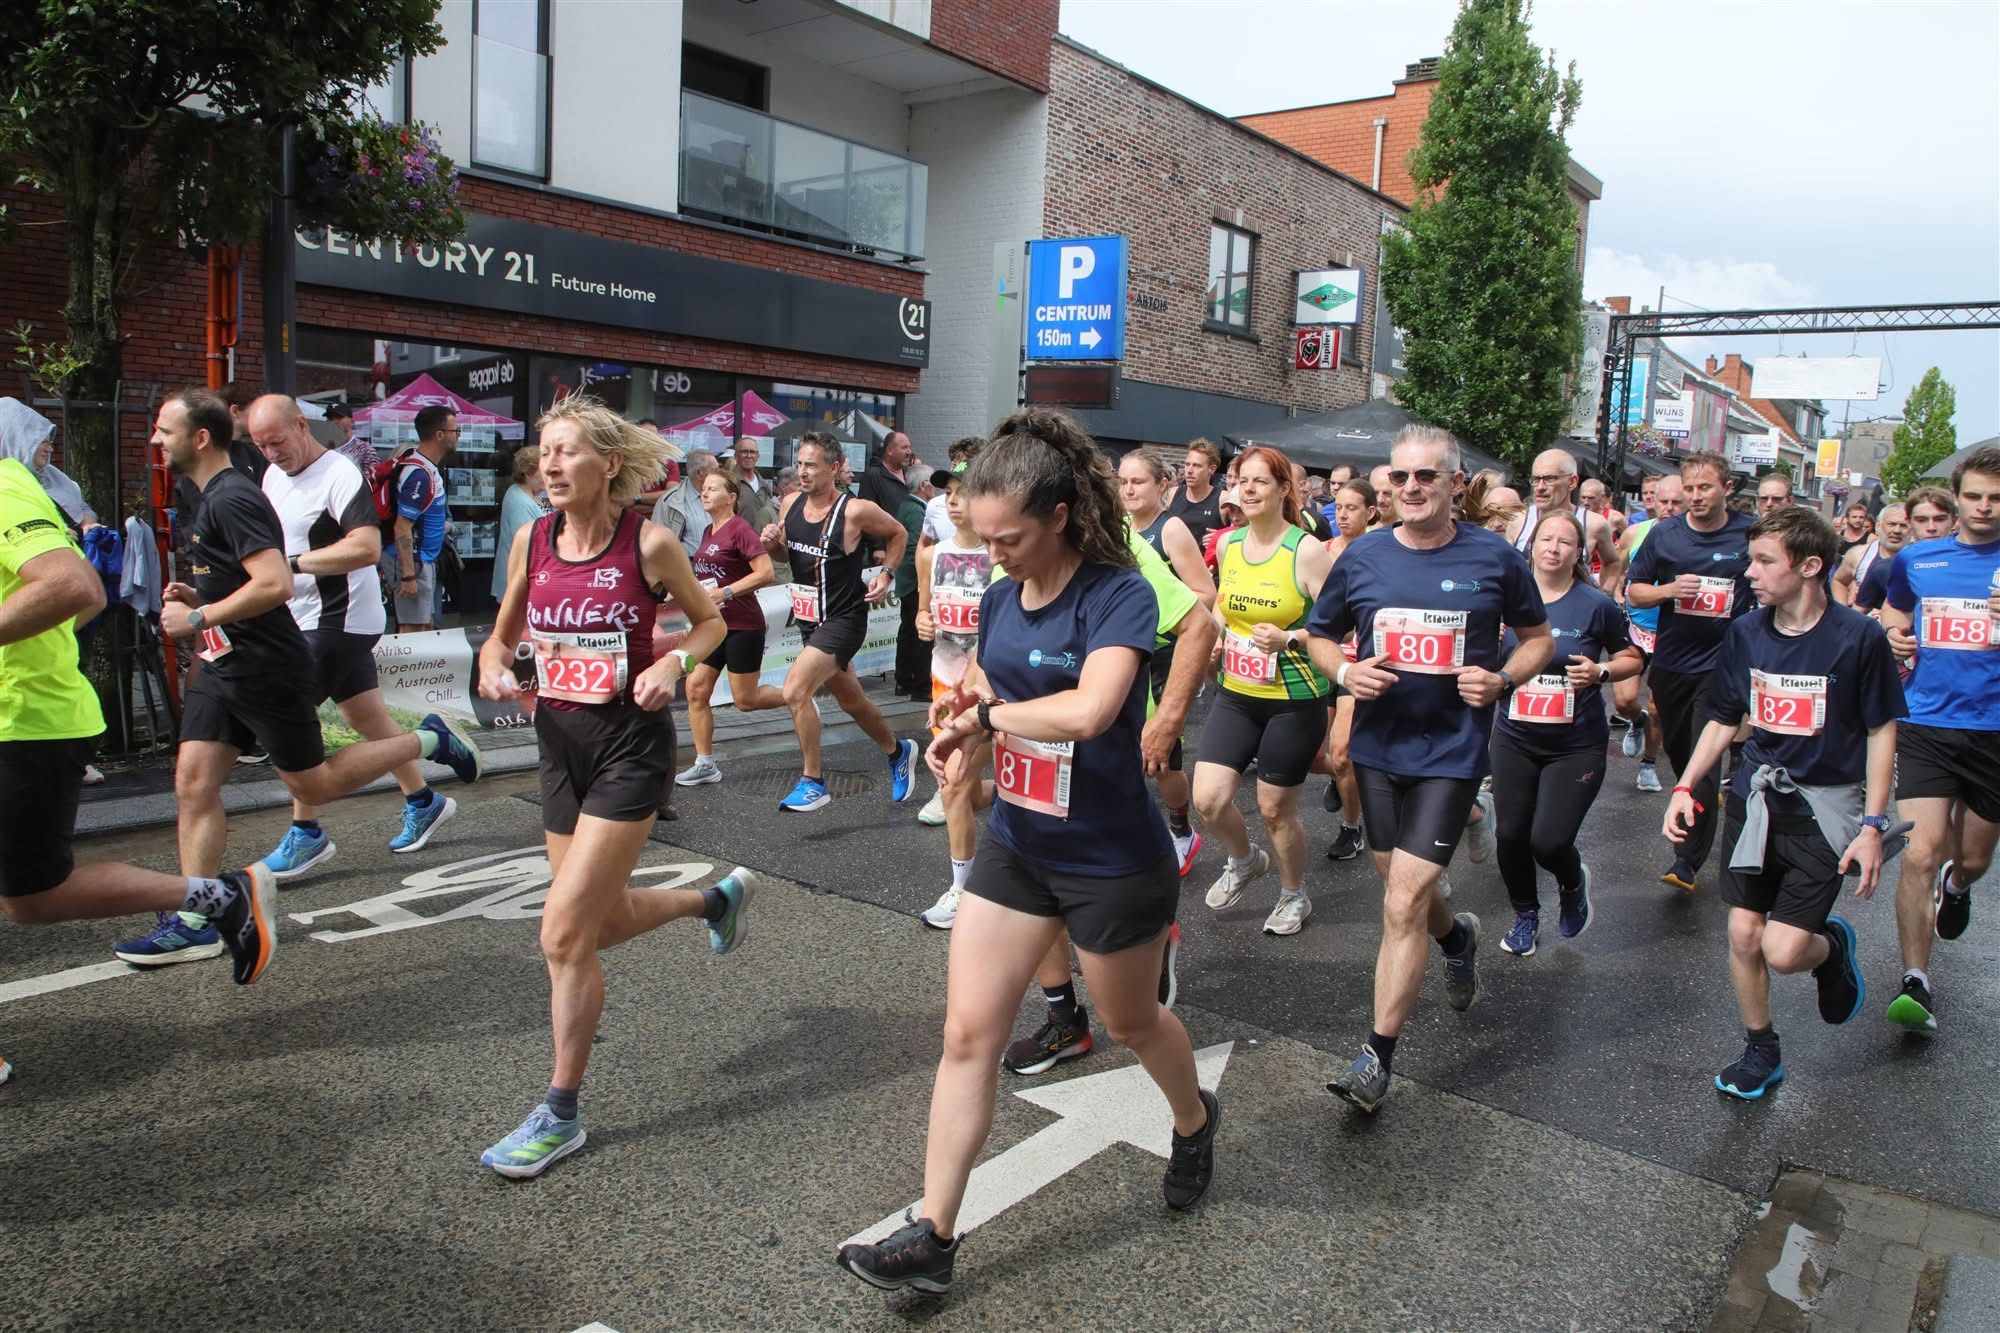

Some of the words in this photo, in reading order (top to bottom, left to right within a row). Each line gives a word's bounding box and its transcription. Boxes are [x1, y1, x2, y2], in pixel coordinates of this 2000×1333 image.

[1059, 246, 1095, 299] P
[551, 273, 606, 295] Future
[610, 284, 656, 303] Home
[1035, 304, 1112, 322] CENTRUM
[1135, 294, 1169, 311] ARTOIS
[1036, 329, 1071, 347] 150m
[1321, 331, 1331, 366] Jupiler
[1655, 407, 1685, 417] WIJNS
[788, 539, 829, 558] DURACELL
[1229, 601, 1247, 612] lab
[1692, 592, 1717, 611] 79
[940, 604, 978, 626] 316
[1933, 618, 1986, 643] 158
[868, 638, 898, 649] WERCHT
[1399, 634, 1439, 664] 80
[547, 659, 611, 693] 232
[1227, 651, 1265, 679] 163
[1524, 693, 1554, 716] 77
[1763, 696, 1798, 726] 82
[1000, 751, 1032, 795] 81
